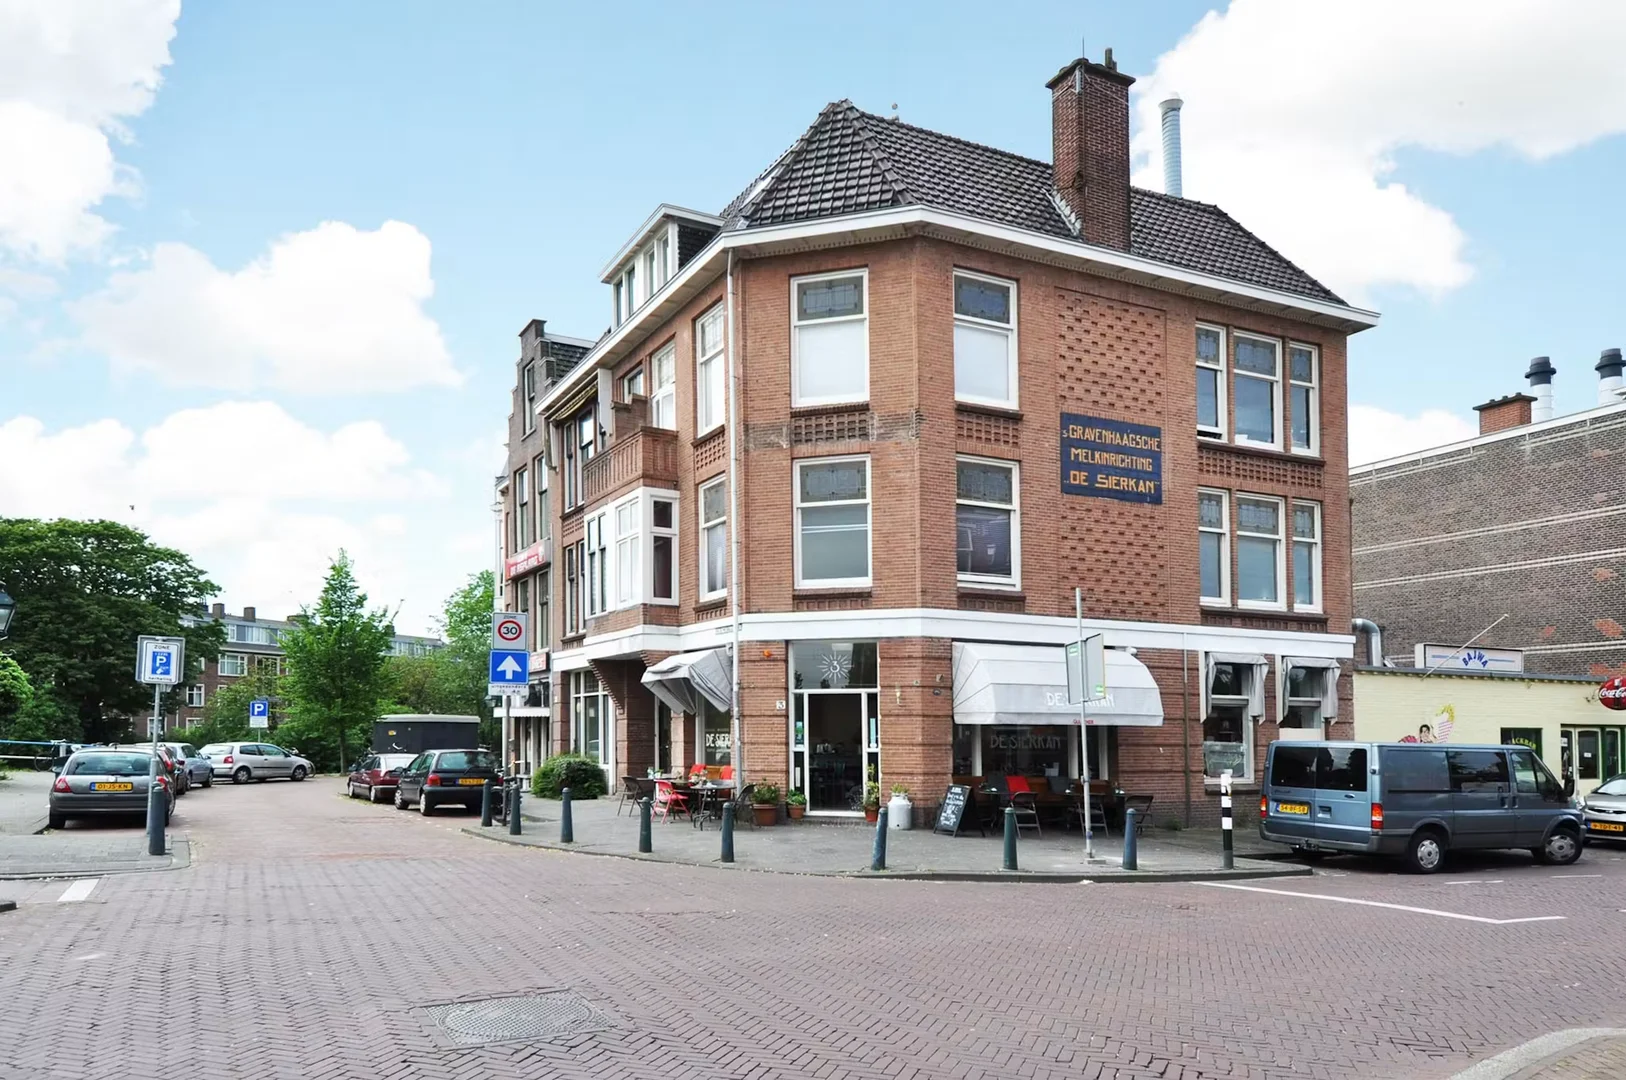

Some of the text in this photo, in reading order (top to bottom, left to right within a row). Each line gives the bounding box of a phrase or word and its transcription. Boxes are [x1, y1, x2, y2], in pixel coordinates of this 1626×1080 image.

[1070, 447, 1153, 471] MELKINRICHTING
[502, 626, 518, 635] 30
[155, 655, 167, 668] P
[1462, 650, 1489, 668] BAJWA
[829, 660, 840, 673] 3
[1046, 692, 1063, 706] DE
[254, 703, 265, 716] P
[705, 733, 715, 747] DE
[990, 736, 1061, 749] DE SIERKAN
